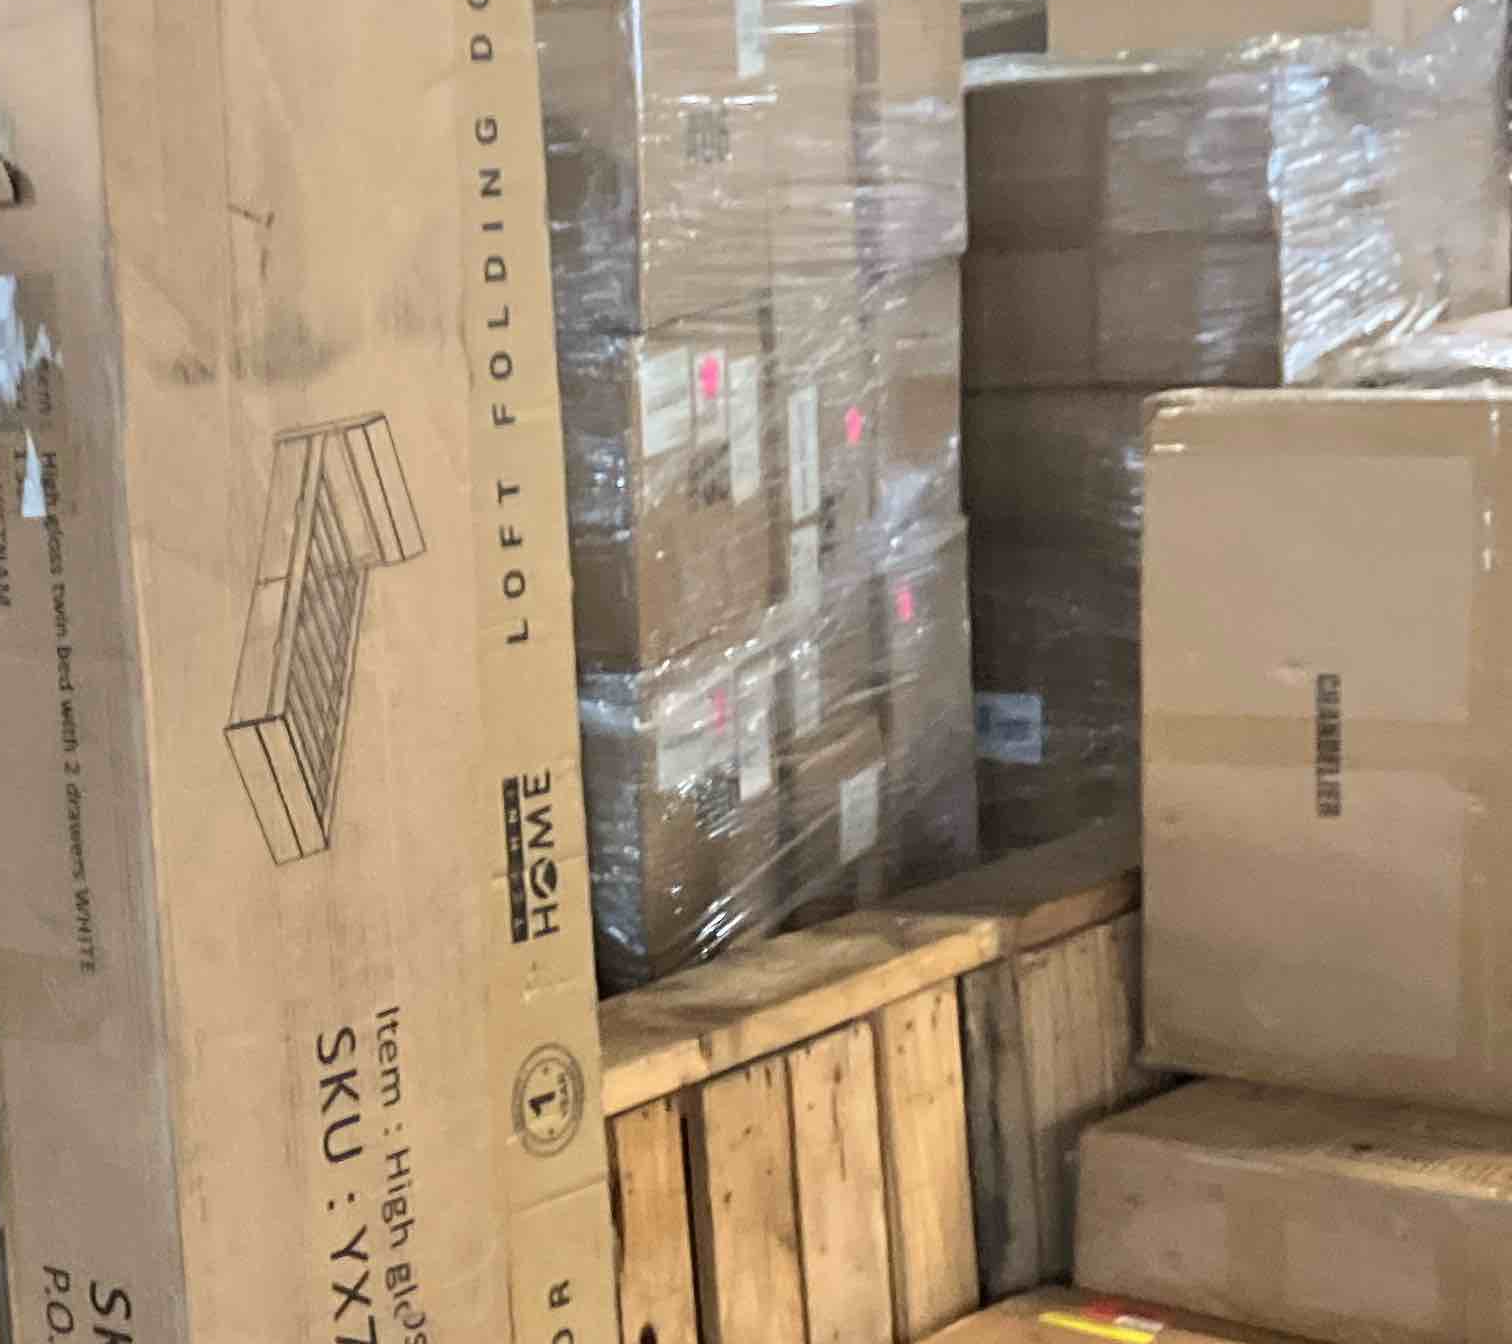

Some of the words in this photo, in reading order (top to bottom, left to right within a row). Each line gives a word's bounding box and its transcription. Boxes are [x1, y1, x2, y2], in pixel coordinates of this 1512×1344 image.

[475, 115, 516, 428] FOLDING
[497, 480, 530, 645] LOFT
[56, 646, 74, 692] bed
[60, 699, 79, 753] with
[64, 761, 80, 775] 2
[65, 782, 86, 881] drawers
[74, 887, 95, 976] WHITE
[316, 1026, 364, 1164] SKU
[376, 1006, 401, 1108] Item
[381, 1146, 416, 1249] High
